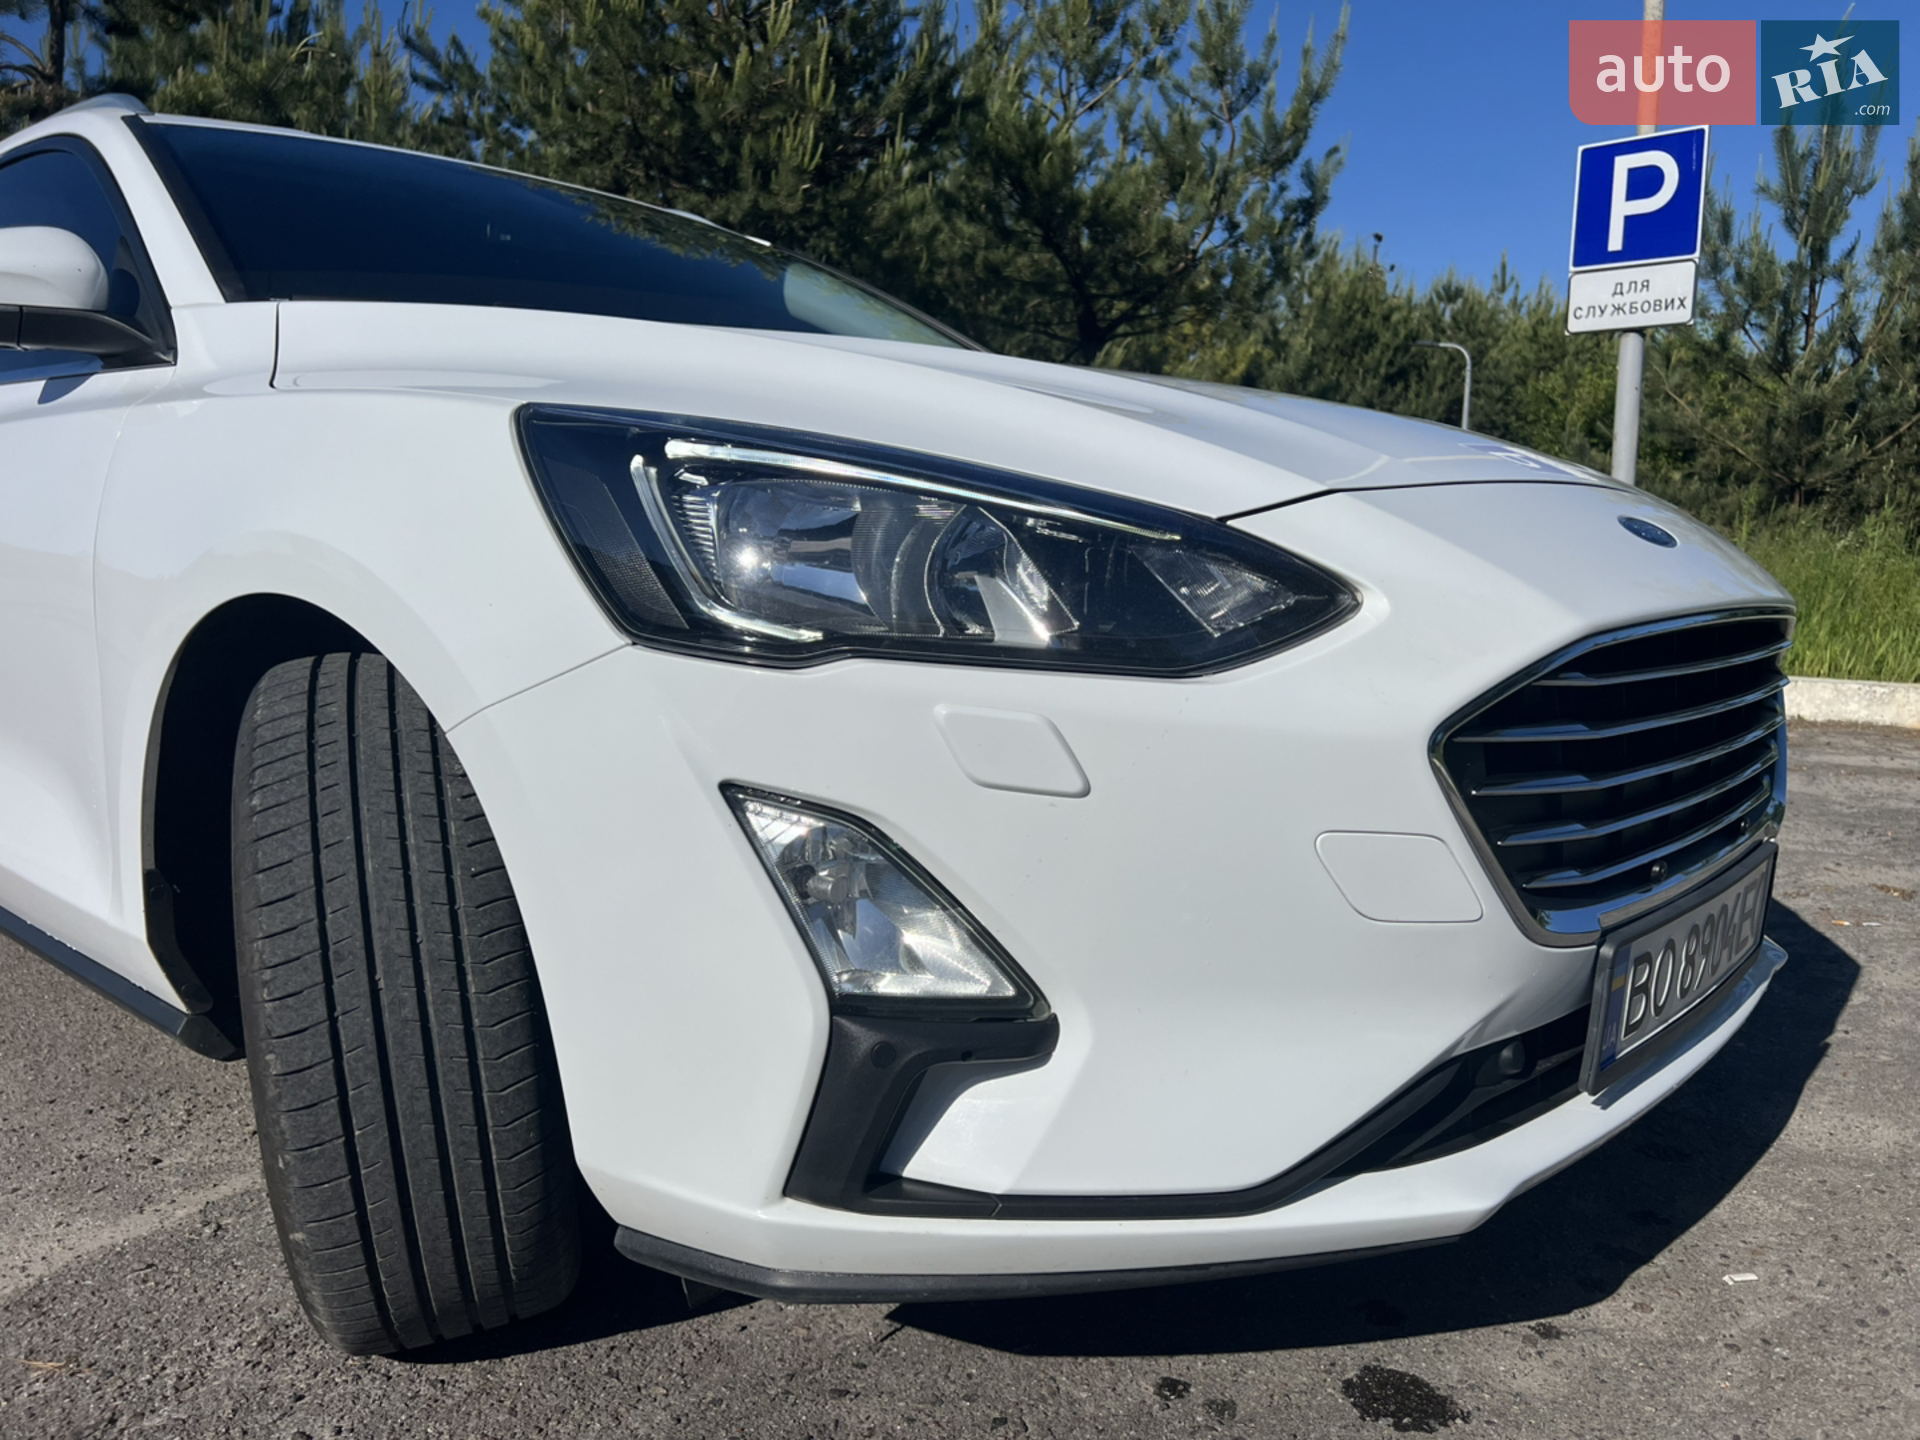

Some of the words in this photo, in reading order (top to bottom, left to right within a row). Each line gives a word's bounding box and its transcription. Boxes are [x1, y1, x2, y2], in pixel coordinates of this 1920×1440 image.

[1607, 150, 1680, 252] P
[1612, 279, 1650, 297] ДЛЯ
[1573, 296, 1687, 320] СЛУЖБОВИХ
